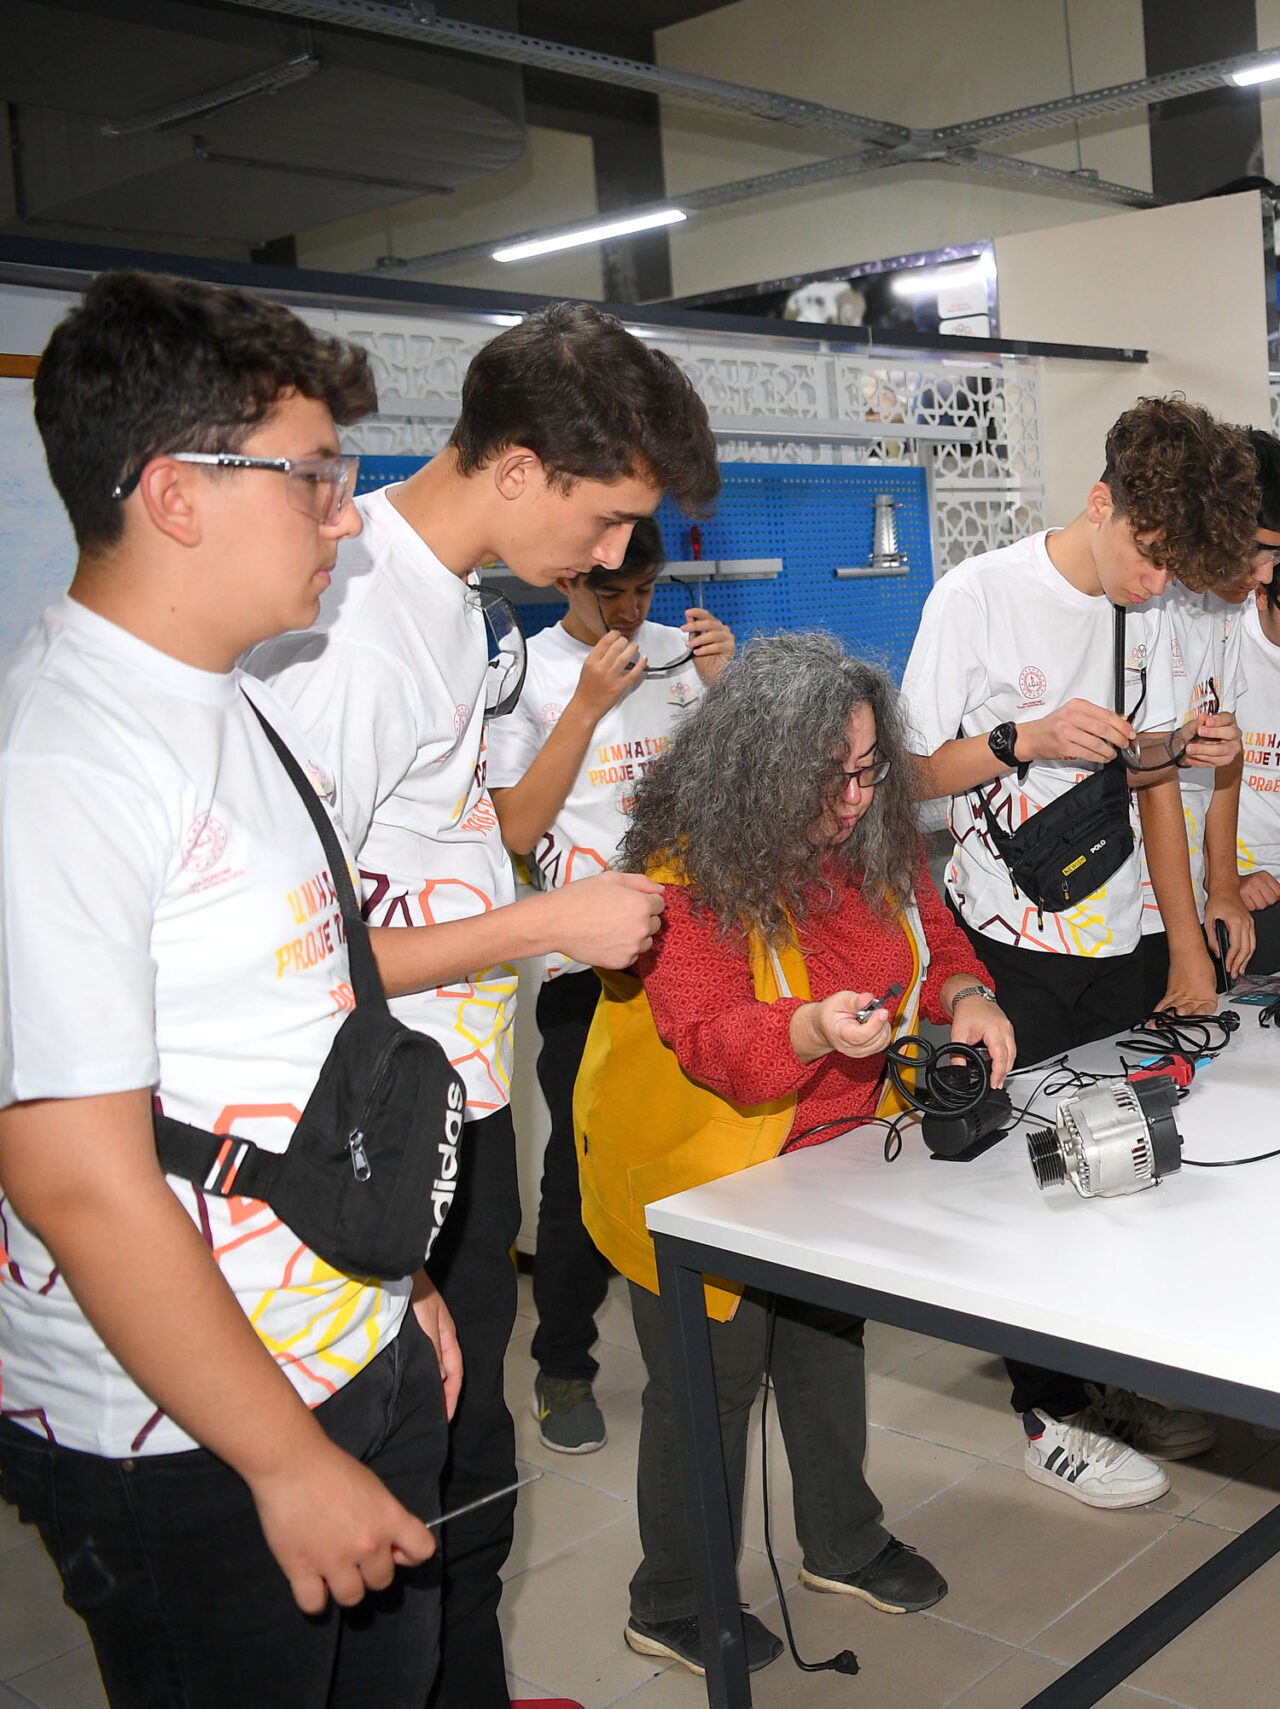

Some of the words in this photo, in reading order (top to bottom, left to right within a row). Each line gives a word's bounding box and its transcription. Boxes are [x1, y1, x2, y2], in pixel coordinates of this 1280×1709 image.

[588, 764, 635, 788] PROJE
[1090, 839, 1106, 854] POLO
[275, 919, 334, 979] PROJE
